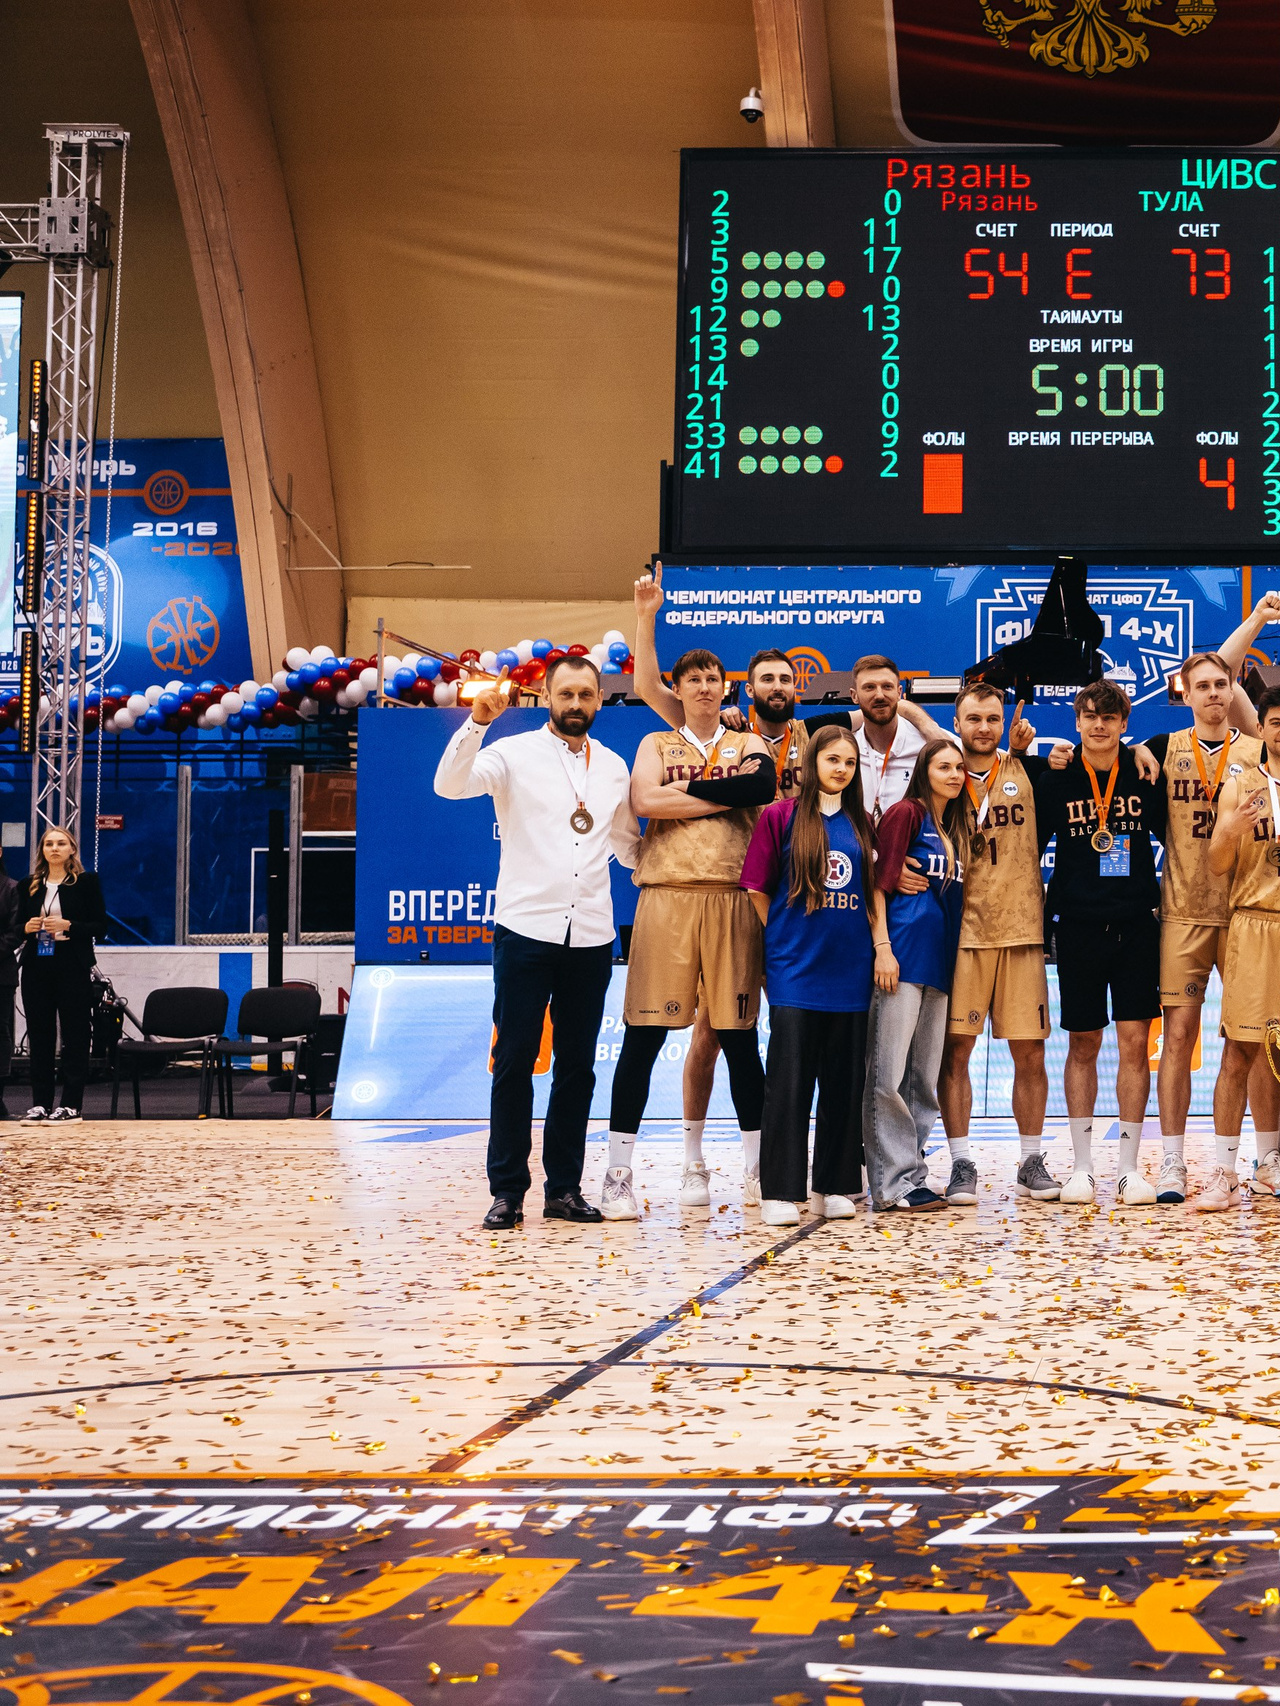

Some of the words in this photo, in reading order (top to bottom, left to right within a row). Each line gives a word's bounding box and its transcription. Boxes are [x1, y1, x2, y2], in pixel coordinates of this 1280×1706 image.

[886, 158, 1031, 189] Рязань
[1181, 158, 1278, 190] ЦИВС
[711, 189, 730, 217] 2
[883, 188, 902, 216] 0
[941, 190, 1039, 212] Рязань
[1138, 190, 1204, 212] ТУЛА
[710, 218, 730, 246] 3
[863, 217, 897, 245] 11
[975, 222, 1018, 238] СЧЕТ
[1050, 222, 1114, 238] ПЕРИОД
[1178, 223, 1221, 238] СЧЕТ
[710, 246, 729, 275] 5
[863, 246, 902, 274] 17
[963, 247, 1029, 300] 54
[1170, 247, 1231, 300] 73
[710, 276, 729, 304] 9
[882, 275, 901, 303] 0
[689, 305, 728, 333] 12
[861, 304, 901, 332] 13
[1039, 309, 1123, 324] ТАЙМАУТЫ
[689, 334, 728, 362] 13
[881, 333, 900, 361] 2
[1028, 338, 1082, 353] ВРЕМЯ
[1091, 338, 1133, 353] ИГРЫ
[688, 363, 729, 391] 14
[881, 362, 900, 390] 0
[1031, 363, 1164, 417] 5:00
[685, 392, 721, 421] 21
[881, 391, 900, 419] 0
[684, 421, 726, 450] 33
[881, 420, 899, 448] 9
[922, 431, 966, 447] ФОЛЫ
[1008, 431, 1062, 446] ВРЕМЯ
[1070, 431, 1155, 446] ПЕРЕРЫВА
[1195, 430, 1239, 446] ФОЛЫ
[683, 451, 721, 479] 41
[879, 450, 899, 477] 2
[1198, 456, 1236, 511] 4
[133, 522, 218, 537] 2016
[665, 589, 775, 606] ЧЕМПИОНАТ
[779, 589, 922, 606] ЦЕНТРАЛЬНОГО
[1028, 593, 1109, 606] ЧЕНАТ
[1111, 593, 1143, 606] ЦФО
[665, 609, 812, 627] ФЕДЕРАЛЬНОГО
[814, 609, 885, 625] ОКРУГА
[1119, 616, 1175, 648] 4-Х
[0, 660, 18, 671] 026
[988, 837, 998, 866] 1
[822, 891, 860, 911] ИВС
[387, 926, 418, 945] ЗА
[423, 926, 495, 945] ТВЕРЬ
[736, 993, 751, 1020] 11
[1037, 1004, 1045, 1030] 1
[627, 1503, 918, 1533] ЦФО
